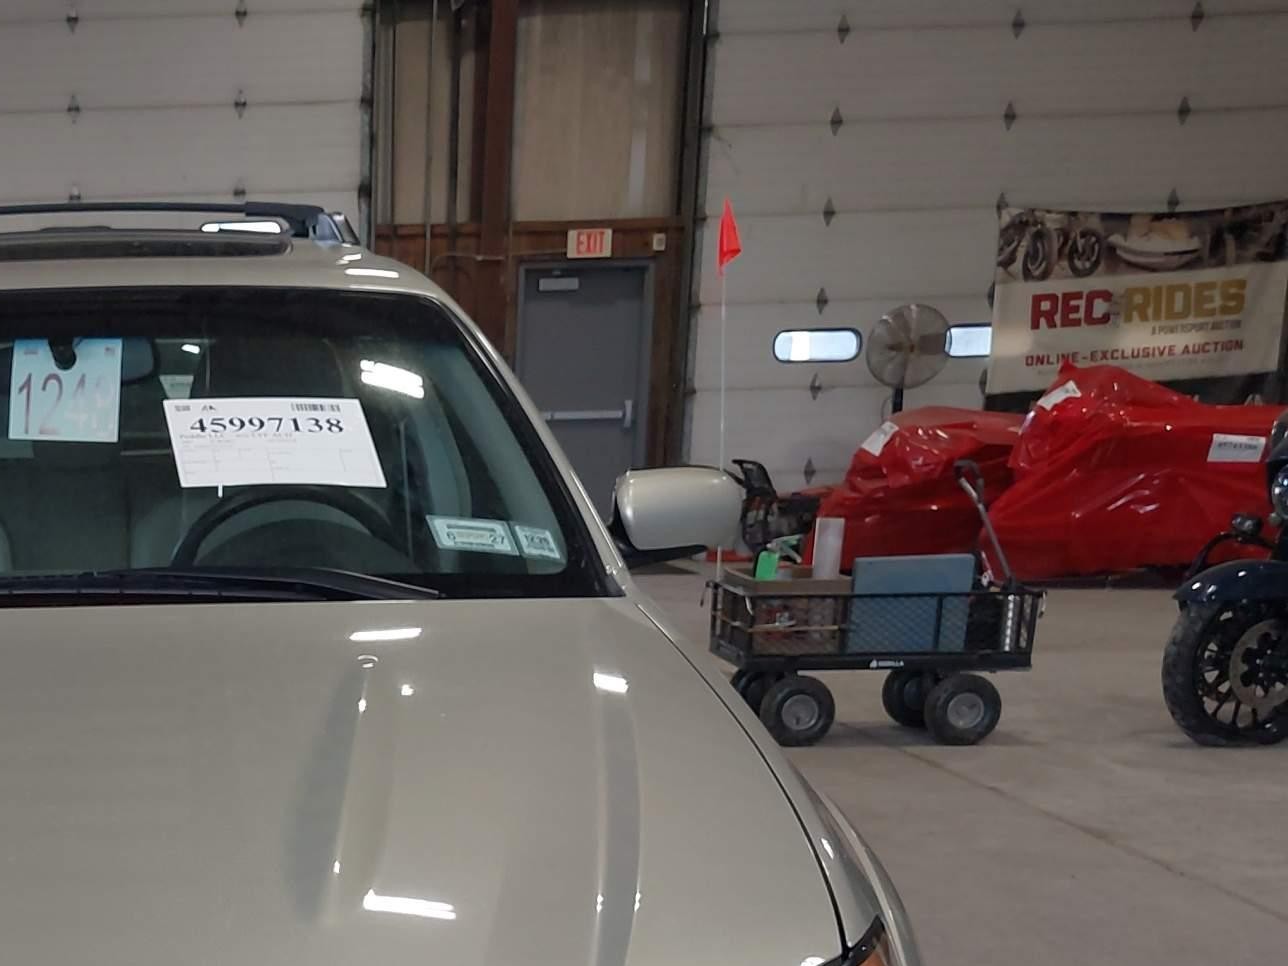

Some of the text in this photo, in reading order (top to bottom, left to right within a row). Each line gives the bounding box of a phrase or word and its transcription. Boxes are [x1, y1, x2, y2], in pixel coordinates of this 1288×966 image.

[577, 230, 605, 255] EXIT
[1031, 280, 1247, 330] REC RIDES
[1181, 339, 1244, 355] AUCTION
[190, 417, 345, 433] 45997138
